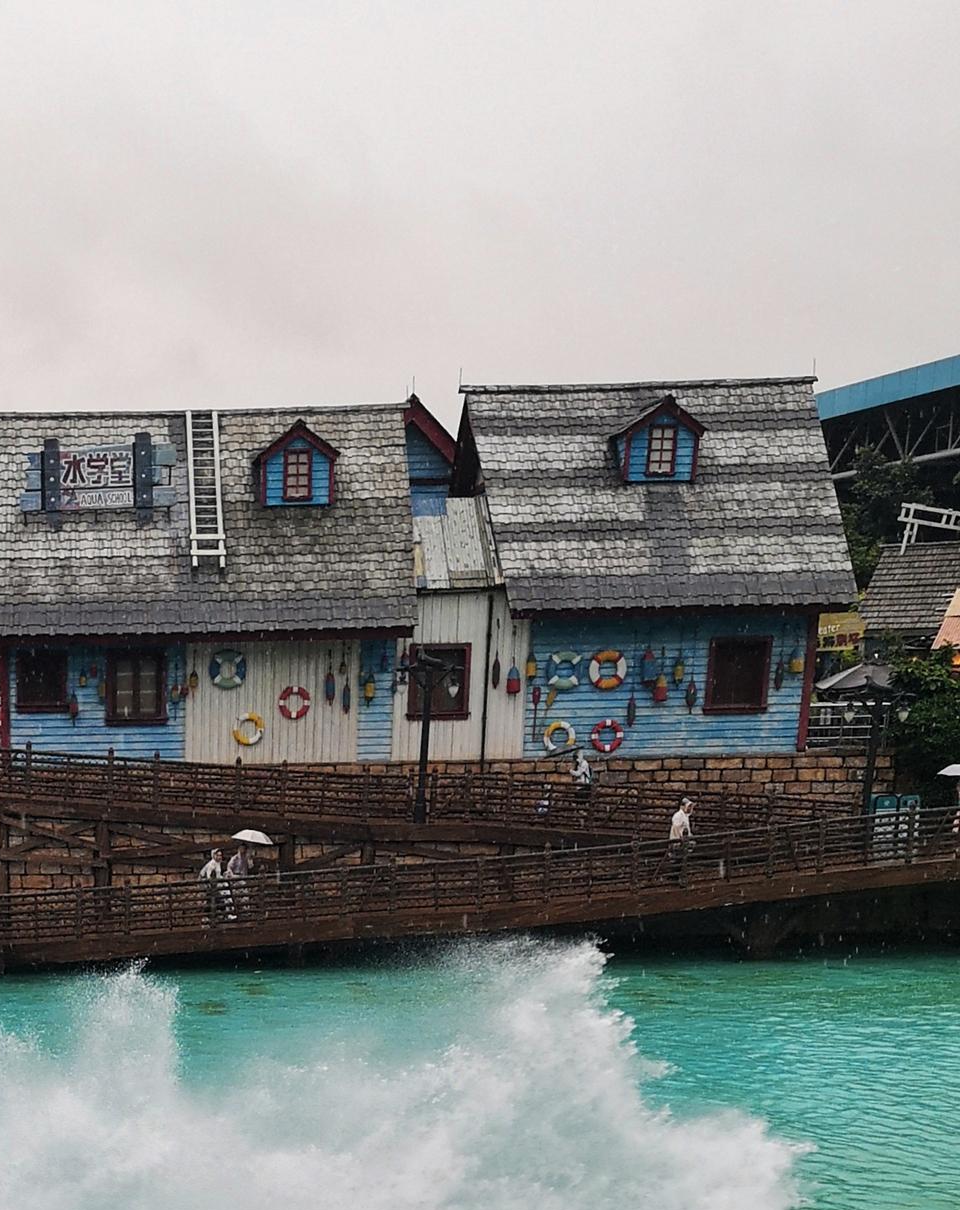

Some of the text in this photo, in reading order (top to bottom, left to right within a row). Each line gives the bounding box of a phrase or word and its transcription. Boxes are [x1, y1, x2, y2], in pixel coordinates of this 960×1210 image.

[61, 452, 132, 486] 水学堂
[80, 491, 132, 506] AQUA SCHOOL
